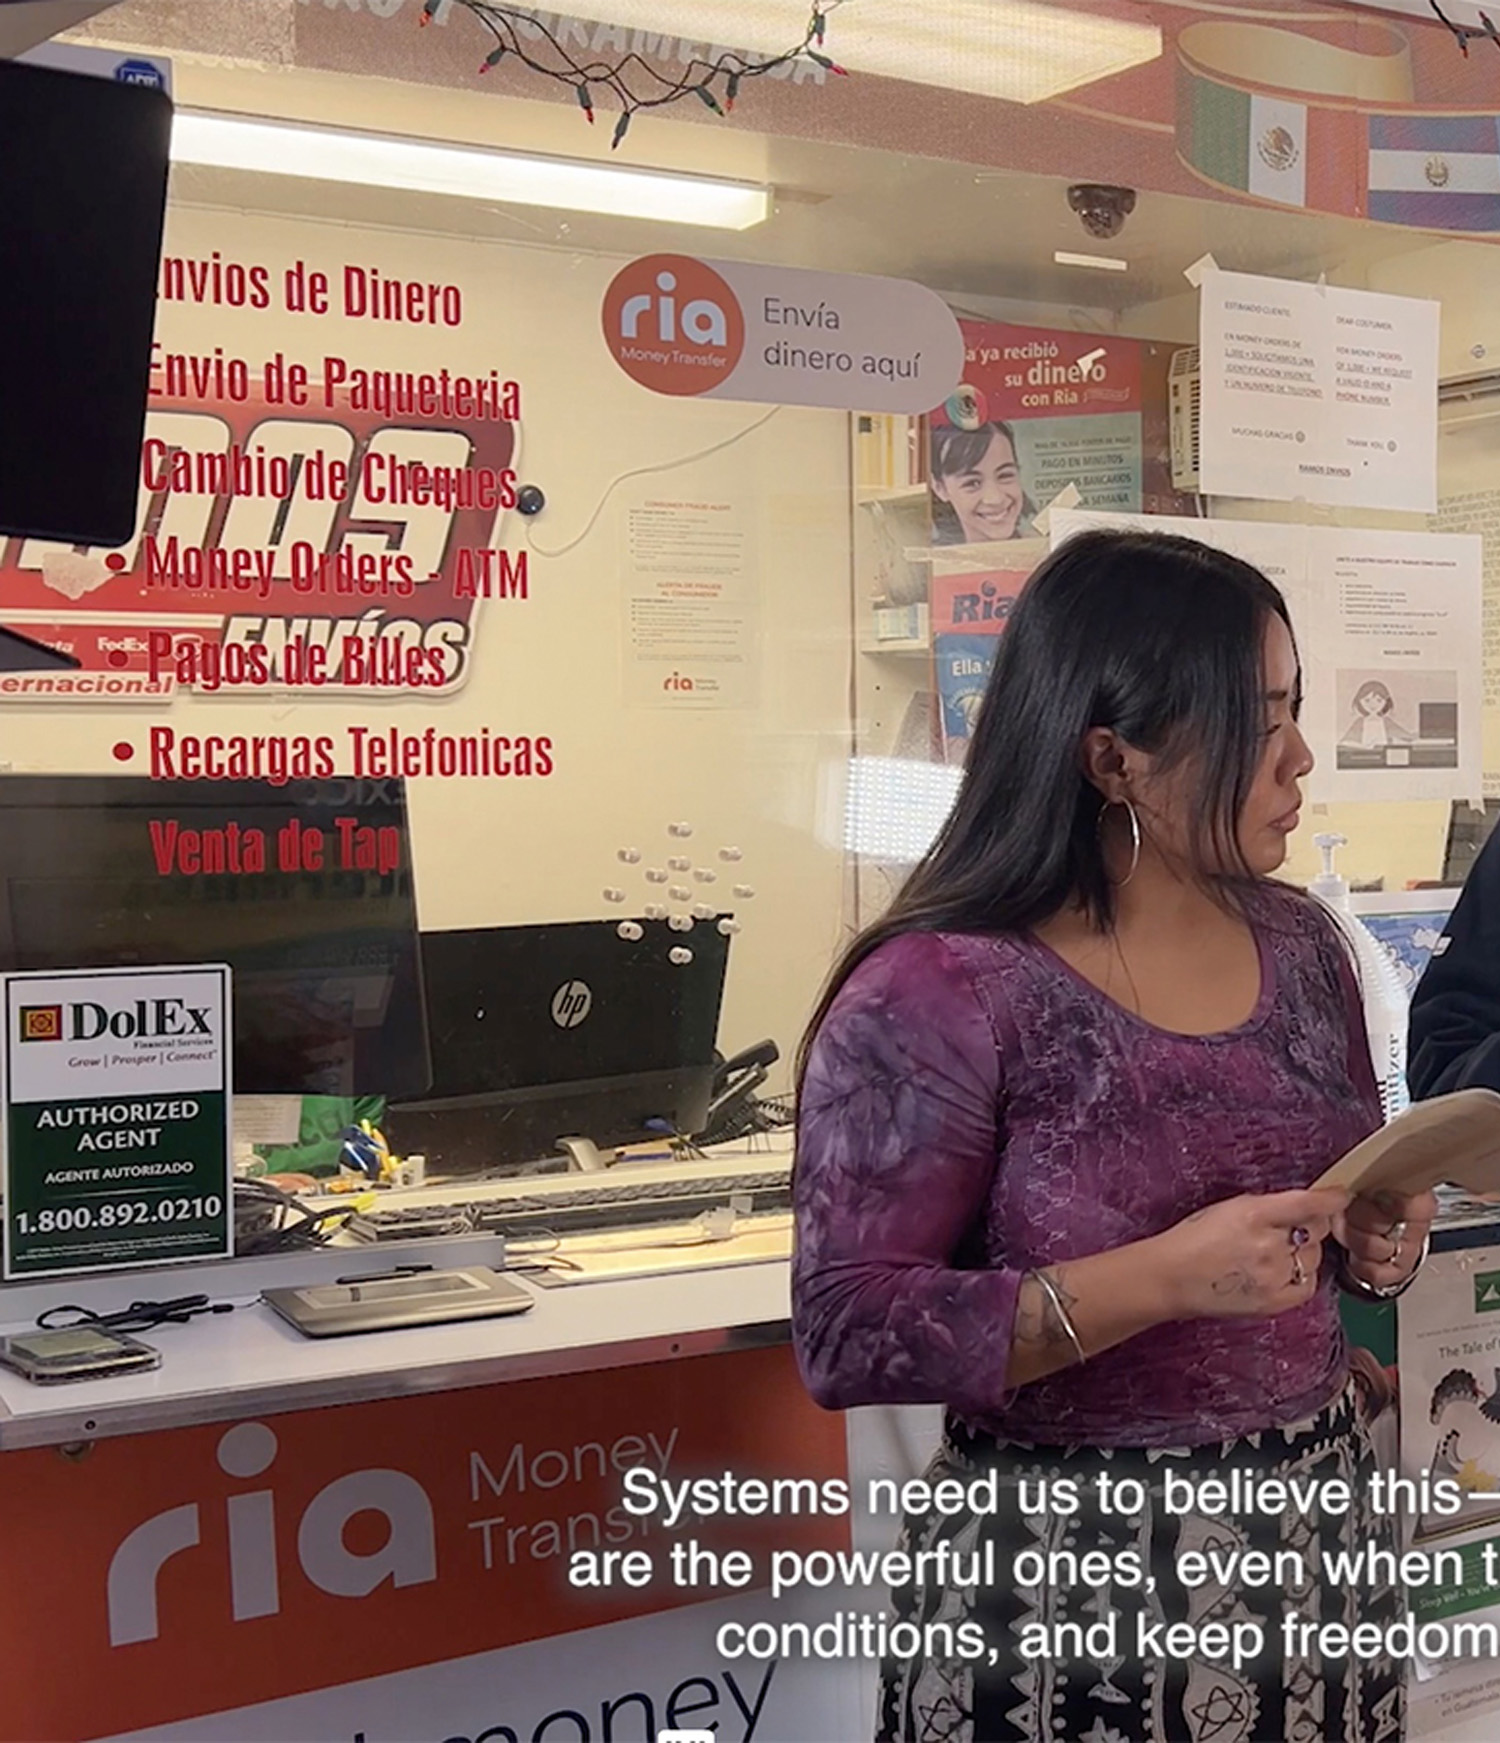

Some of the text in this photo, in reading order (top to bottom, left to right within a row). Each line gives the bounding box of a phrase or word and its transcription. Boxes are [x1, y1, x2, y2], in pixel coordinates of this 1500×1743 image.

[156, 252, 462, 327] nvios de Dinero
[621, 271, 727, 347] ria
[764, 298, 840, 331] Envía
[621, 345, 727, 369] Money Transfer
[764, 341, 921, 382] dinero aquí
[981, 341, 1059, 365] ya recibió
[264, 353, 308, 407] de
[324, 357, 520, 422] Paqueteria
[1005, 374, 1023, 387] su
[1021, 394, 1050, 407] con
[1053, 390, 1079, 406] Ria
[142, 438, 518, 512] Cambio de Cheques
[143, 535, 276, 600] Money
[290, 541, 414, 597] Orders
[454, 547, 529, 599] ATM
[148, 631, 272, 691] Pagos
[284, 636, 330, 687] de
[664, 671, 693, 691] ria
[952, 660, 982, 677] Ella
[150, 727, 553, 786] Recargas Telefonicas
[149, 817, 399, 876] Venta de Tap
[68, 998, 213, 1042] DolEx
[68, 1056, 101, 1068] Grow
[112, 1054, 157, 1068] Prosper
[36, 1101, 200, 1129] AUTHORIZED
[77, 1127, 162, 1152] AGENT
[45, 1161, 194, 1184] AGENTE AUTORIZADO
[16, 1196, 222, 1235] 1.800.892.0210
[469, 1427, 679, 1502] Money
[107, 1422, 437, 1648] ria
[440, 1659, 777, 1743] oney
